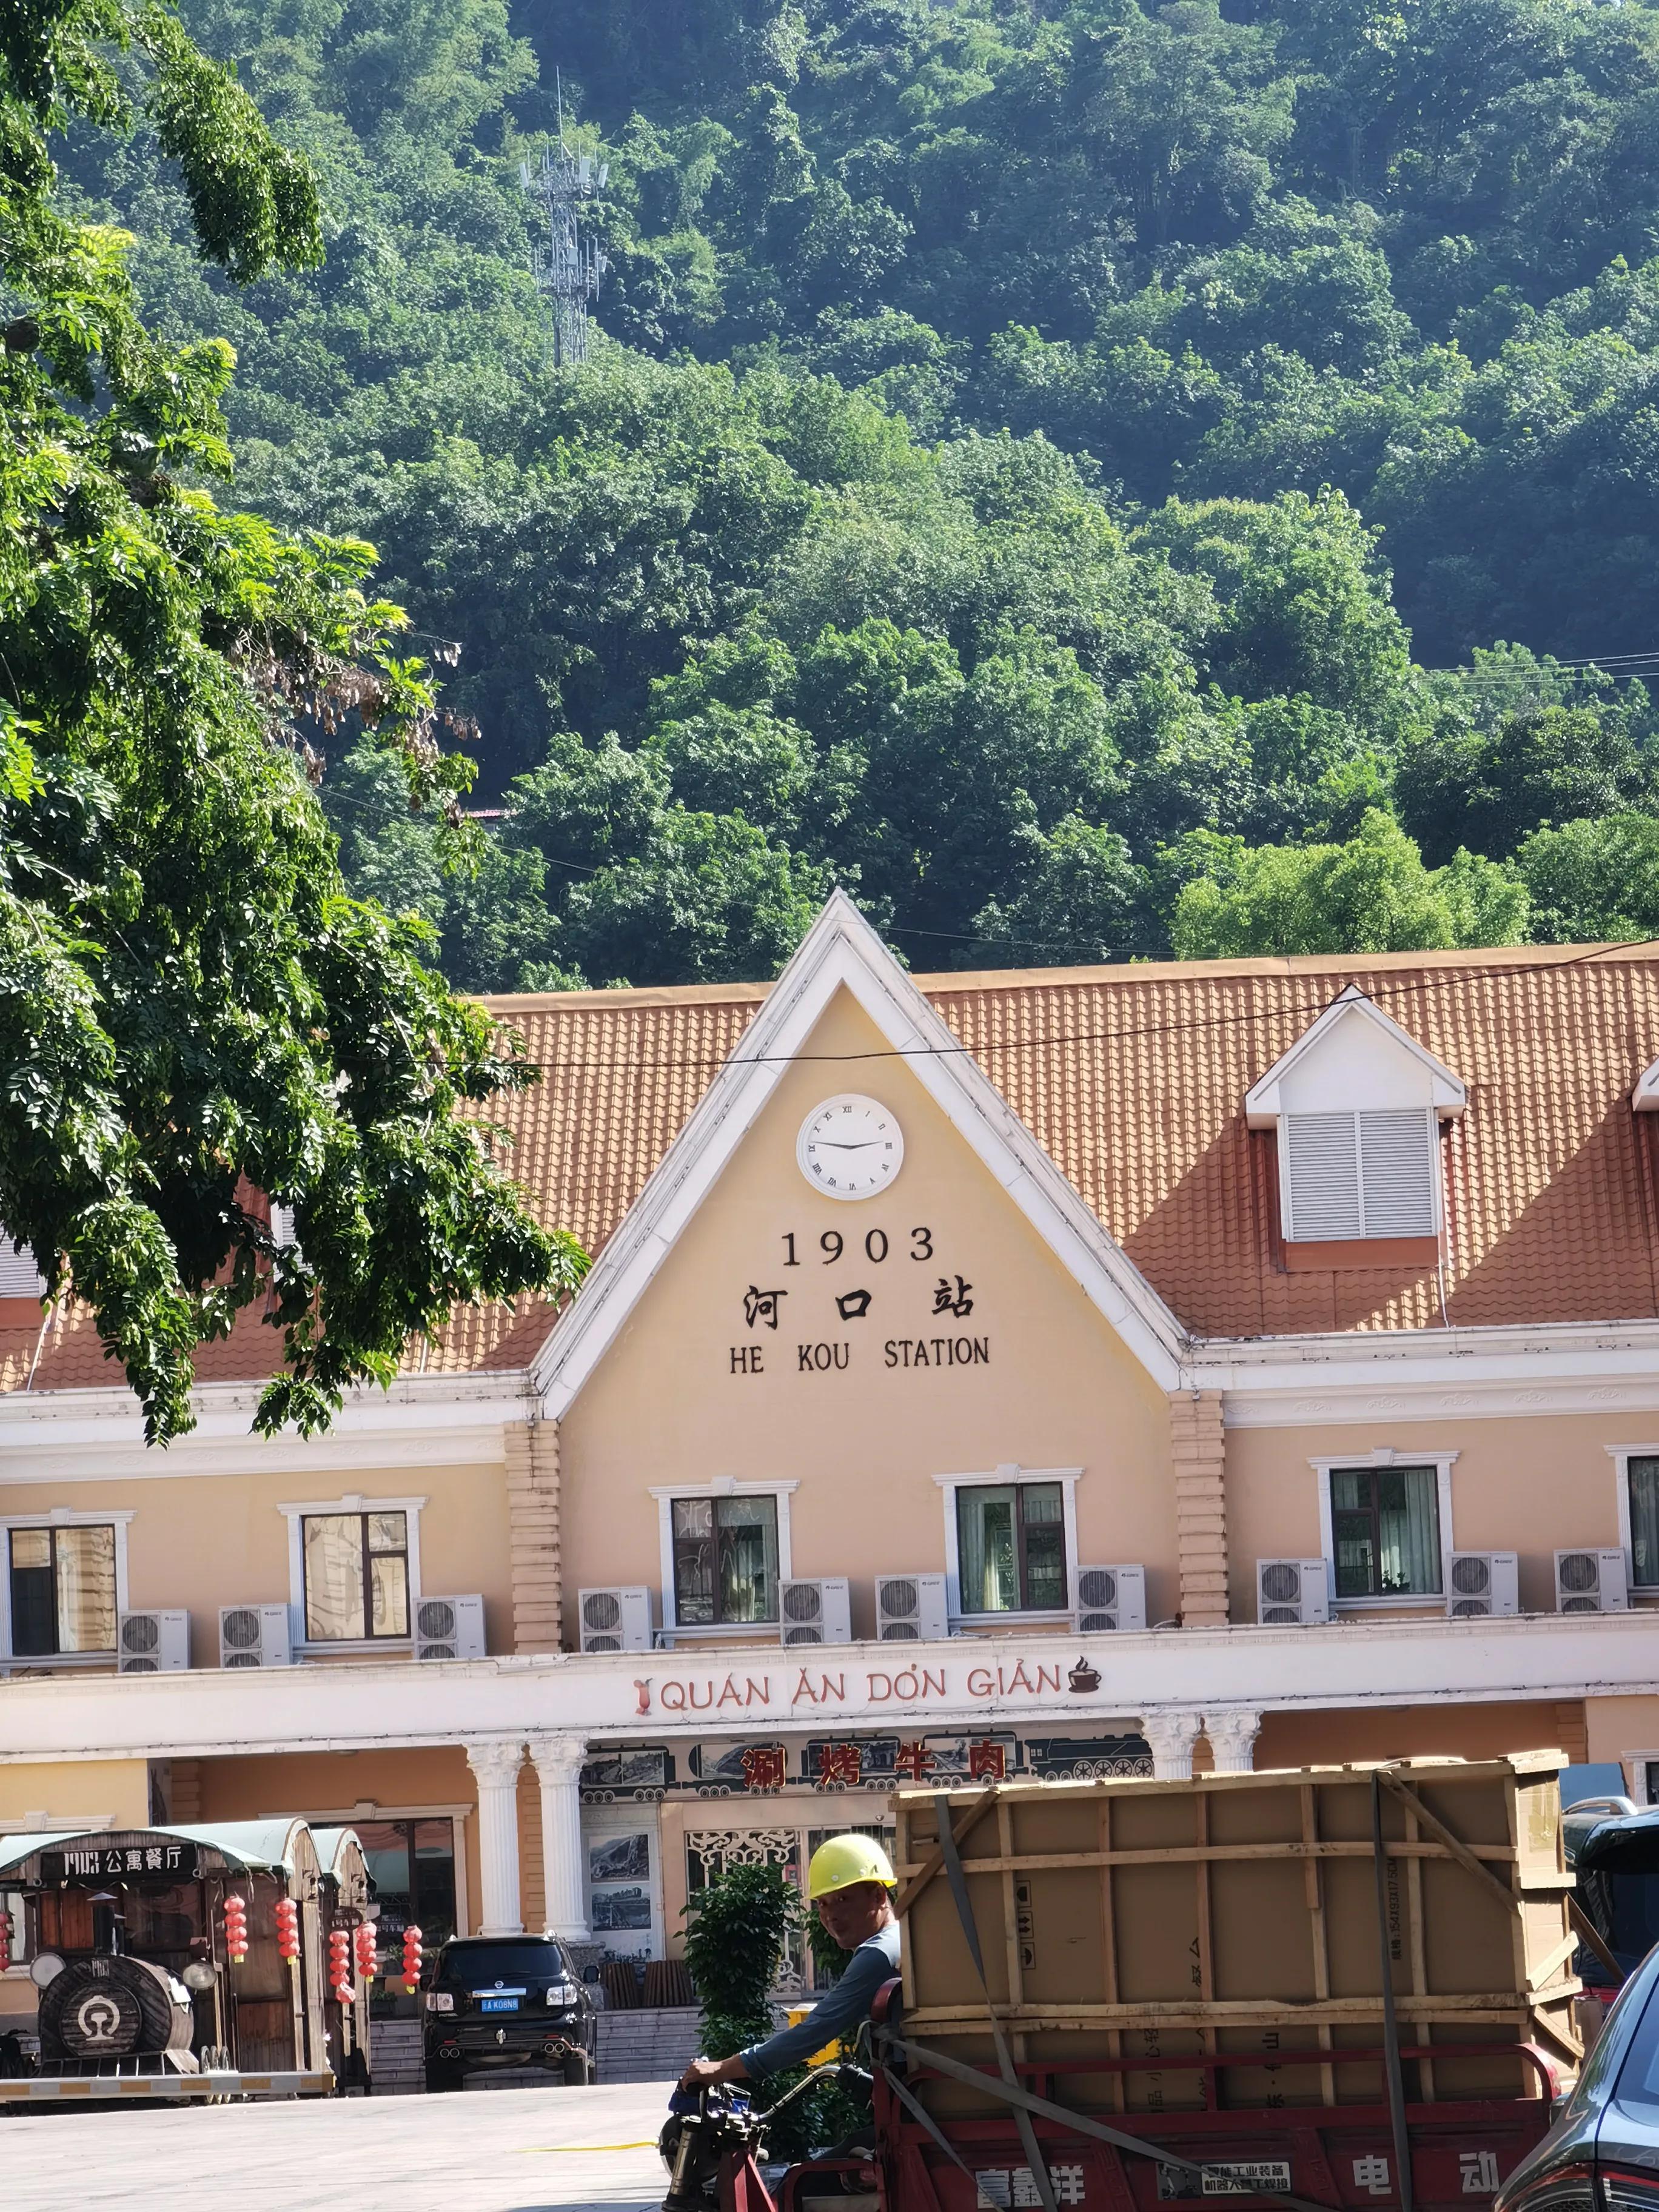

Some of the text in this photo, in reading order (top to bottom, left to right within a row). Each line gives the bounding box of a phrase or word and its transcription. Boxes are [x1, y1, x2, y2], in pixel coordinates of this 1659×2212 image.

[823, 1111, 833, 1121] XI
[808, 1144, 816, 1153] IX
[881, 1164, 890, 1172] IV
[782, 1227, 934, 1267] 1903
[743, 1275, 974, 1330] 河口站
[729, 1336, 990, 1374] HE KOU STATION
[740, 1738, 1006, 1788] 涮烤牛肉
[106, 1846, 182, 1874] 公寓餐厅
